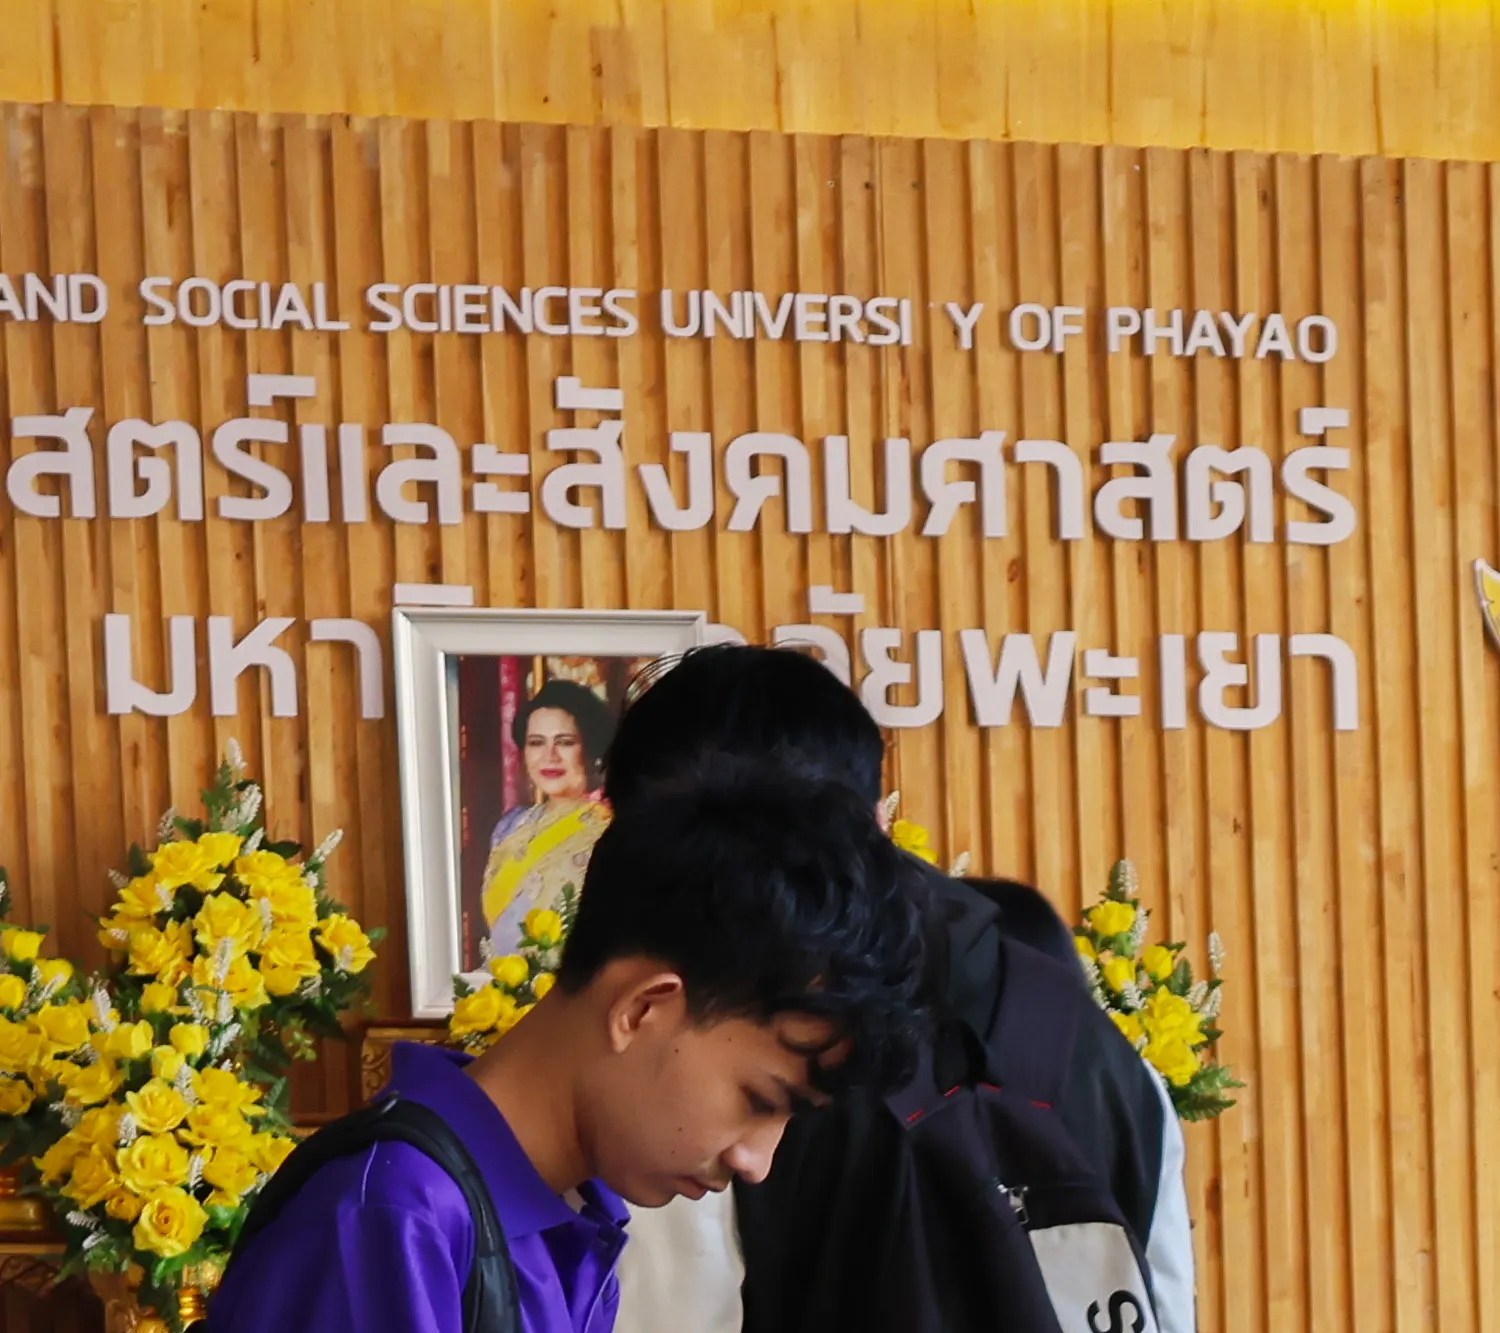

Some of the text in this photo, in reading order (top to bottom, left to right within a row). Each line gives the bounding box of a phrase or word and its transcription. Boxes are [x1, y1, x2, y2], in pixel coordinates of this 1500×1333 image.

[0, 273, 107, 323] AND
[142, 276, 349, 331] SOCIAL
[366, 283, 639, 338] SCIENCES
[1010, 303, 1084, 354] OF
[1106, 306, 1338, 364] PHAYAO
